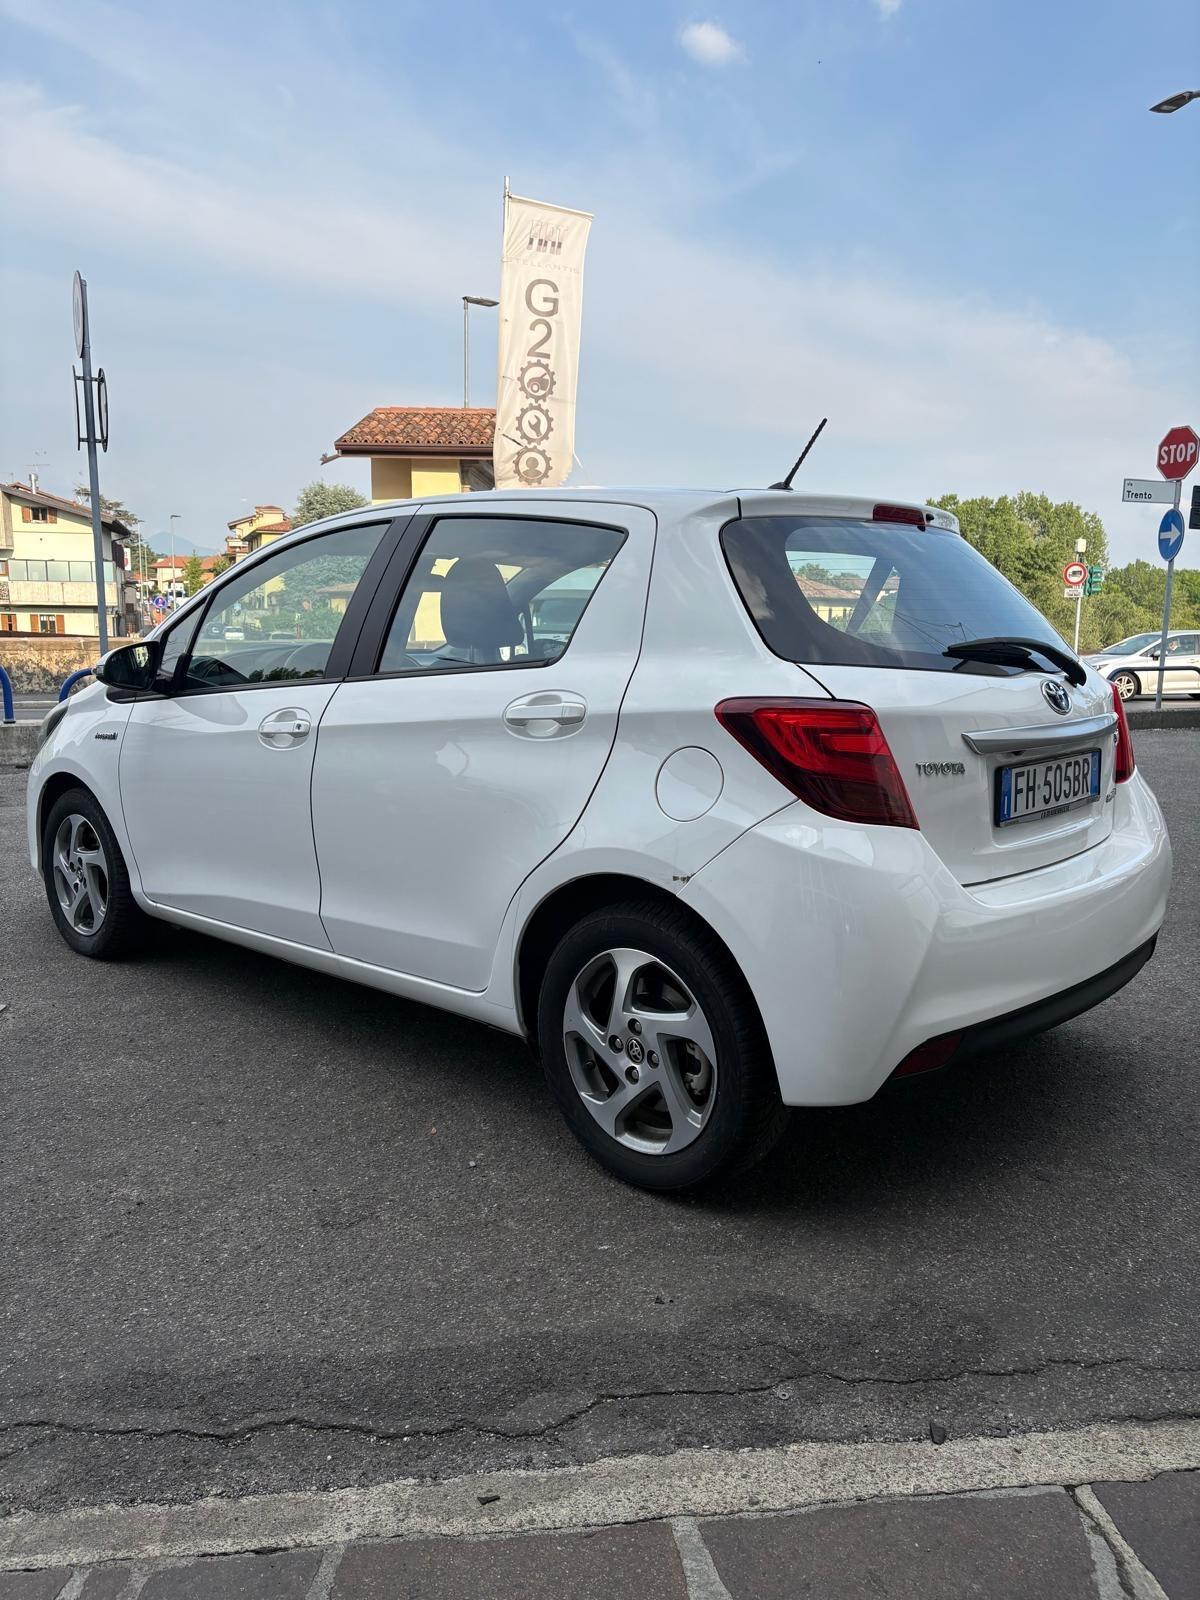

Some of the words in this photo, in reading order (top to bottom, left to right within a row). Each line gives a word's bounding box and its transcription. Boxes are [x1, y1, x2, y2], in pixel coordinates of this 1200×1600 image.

[1159, 441, 1196, 465] STOP
[1126, 490, 1153, 500] Trento
[915, 762, 966, 777] TOYOTA
